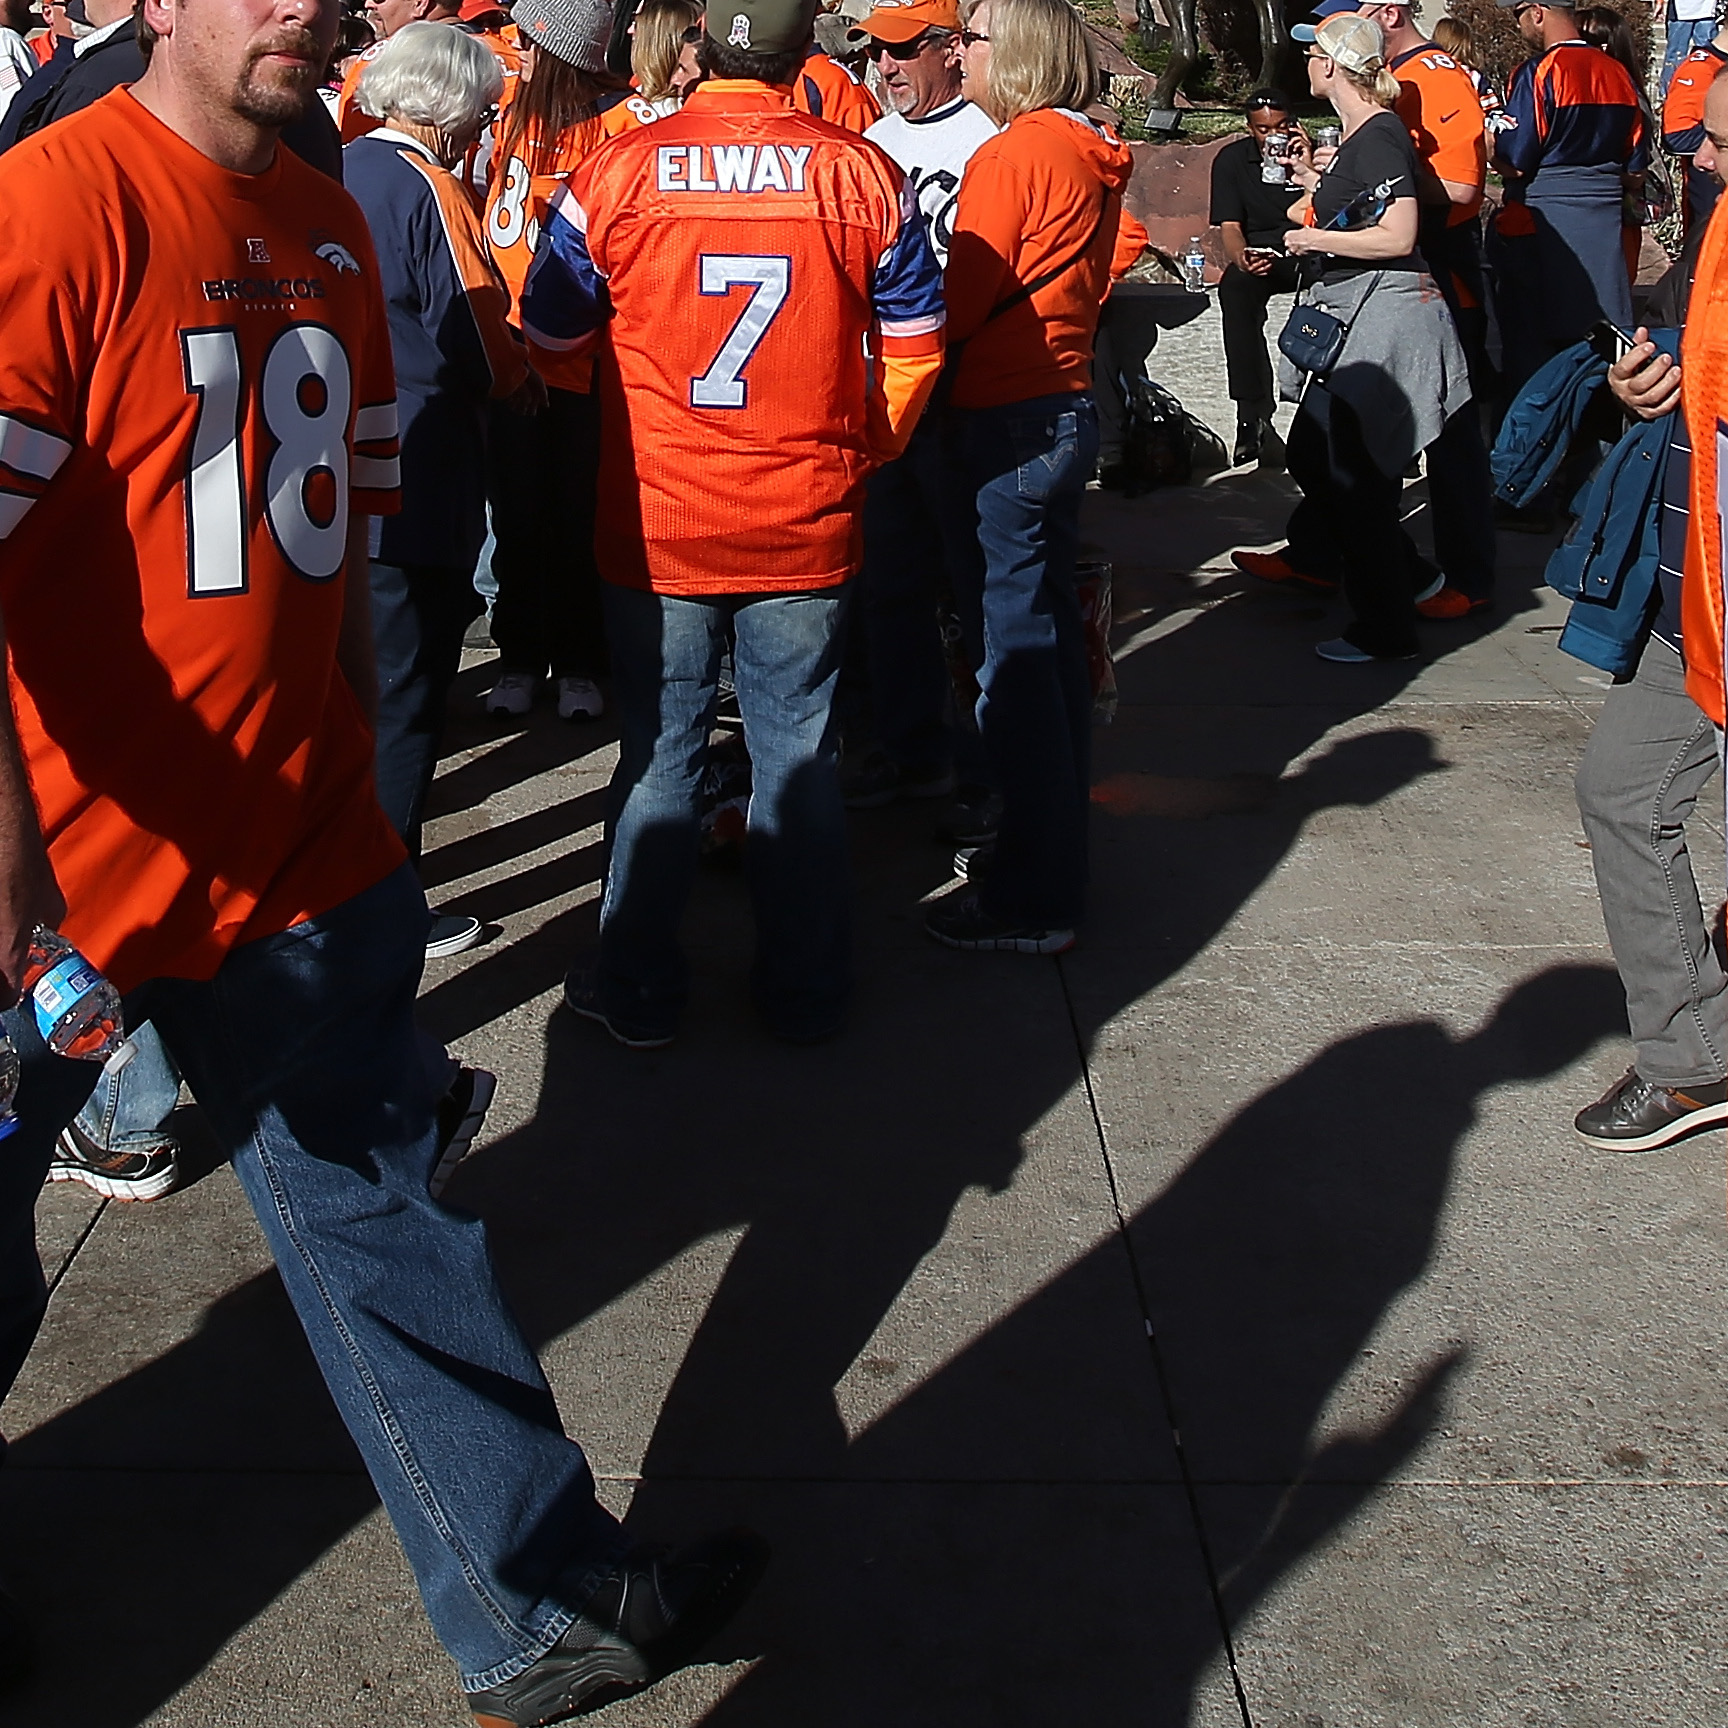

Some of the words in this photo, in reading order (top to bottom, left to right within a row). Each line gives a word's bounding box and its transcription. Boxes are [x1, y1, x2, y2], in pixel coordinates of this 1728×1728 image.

[1419, 53, 1457, 70] 18
[656, 144, 815, 193] ELWAY
[201, 277, 326, 302] BRONCOS
[691, 254, 792, 408] 7
[178, 319, 353, 600] 18
